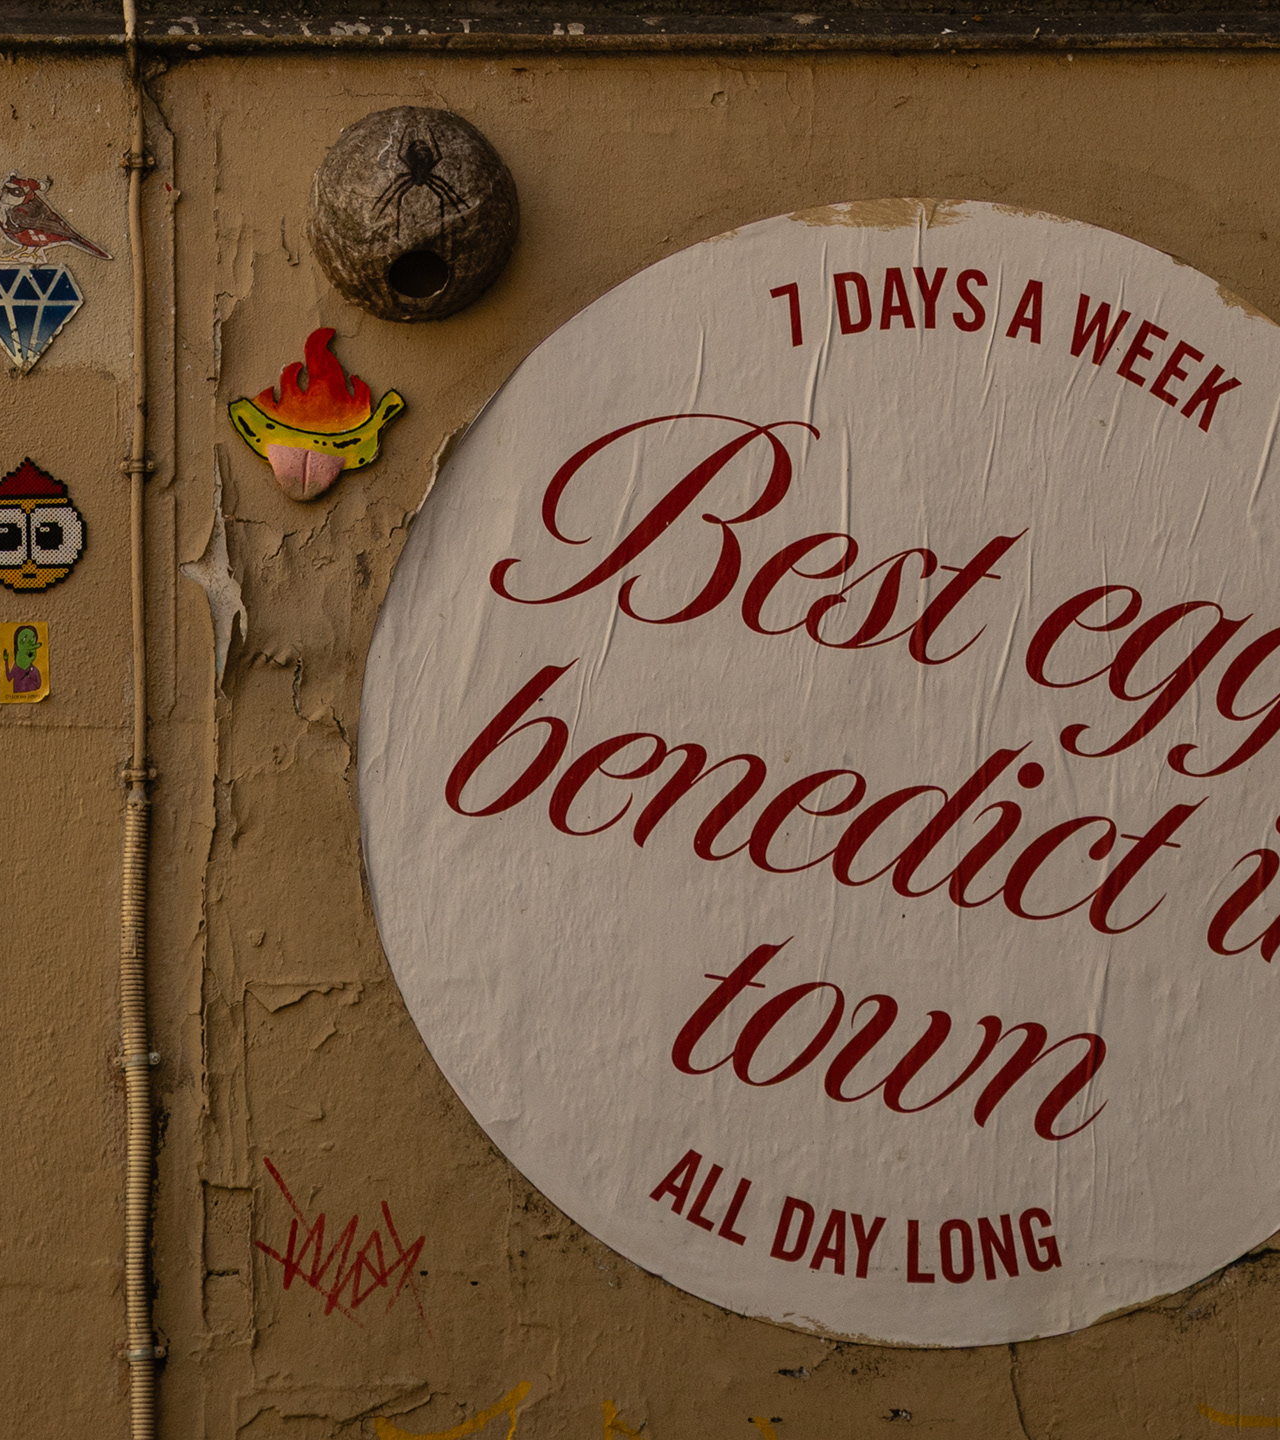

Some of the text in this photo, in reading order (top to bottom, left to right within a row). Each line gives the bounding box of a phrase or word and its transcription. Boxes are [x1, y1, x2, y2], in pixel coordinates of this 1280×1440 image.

[769, 266, 1243, 433] 7 DAYS A WEEK
[489, 413, 1029, 666] Best
[444, 658, 1208, 935] benedict
[671, 936, 1108, 1141] town
[649, 1149, 1063, 1284] ALL DAY LONG
